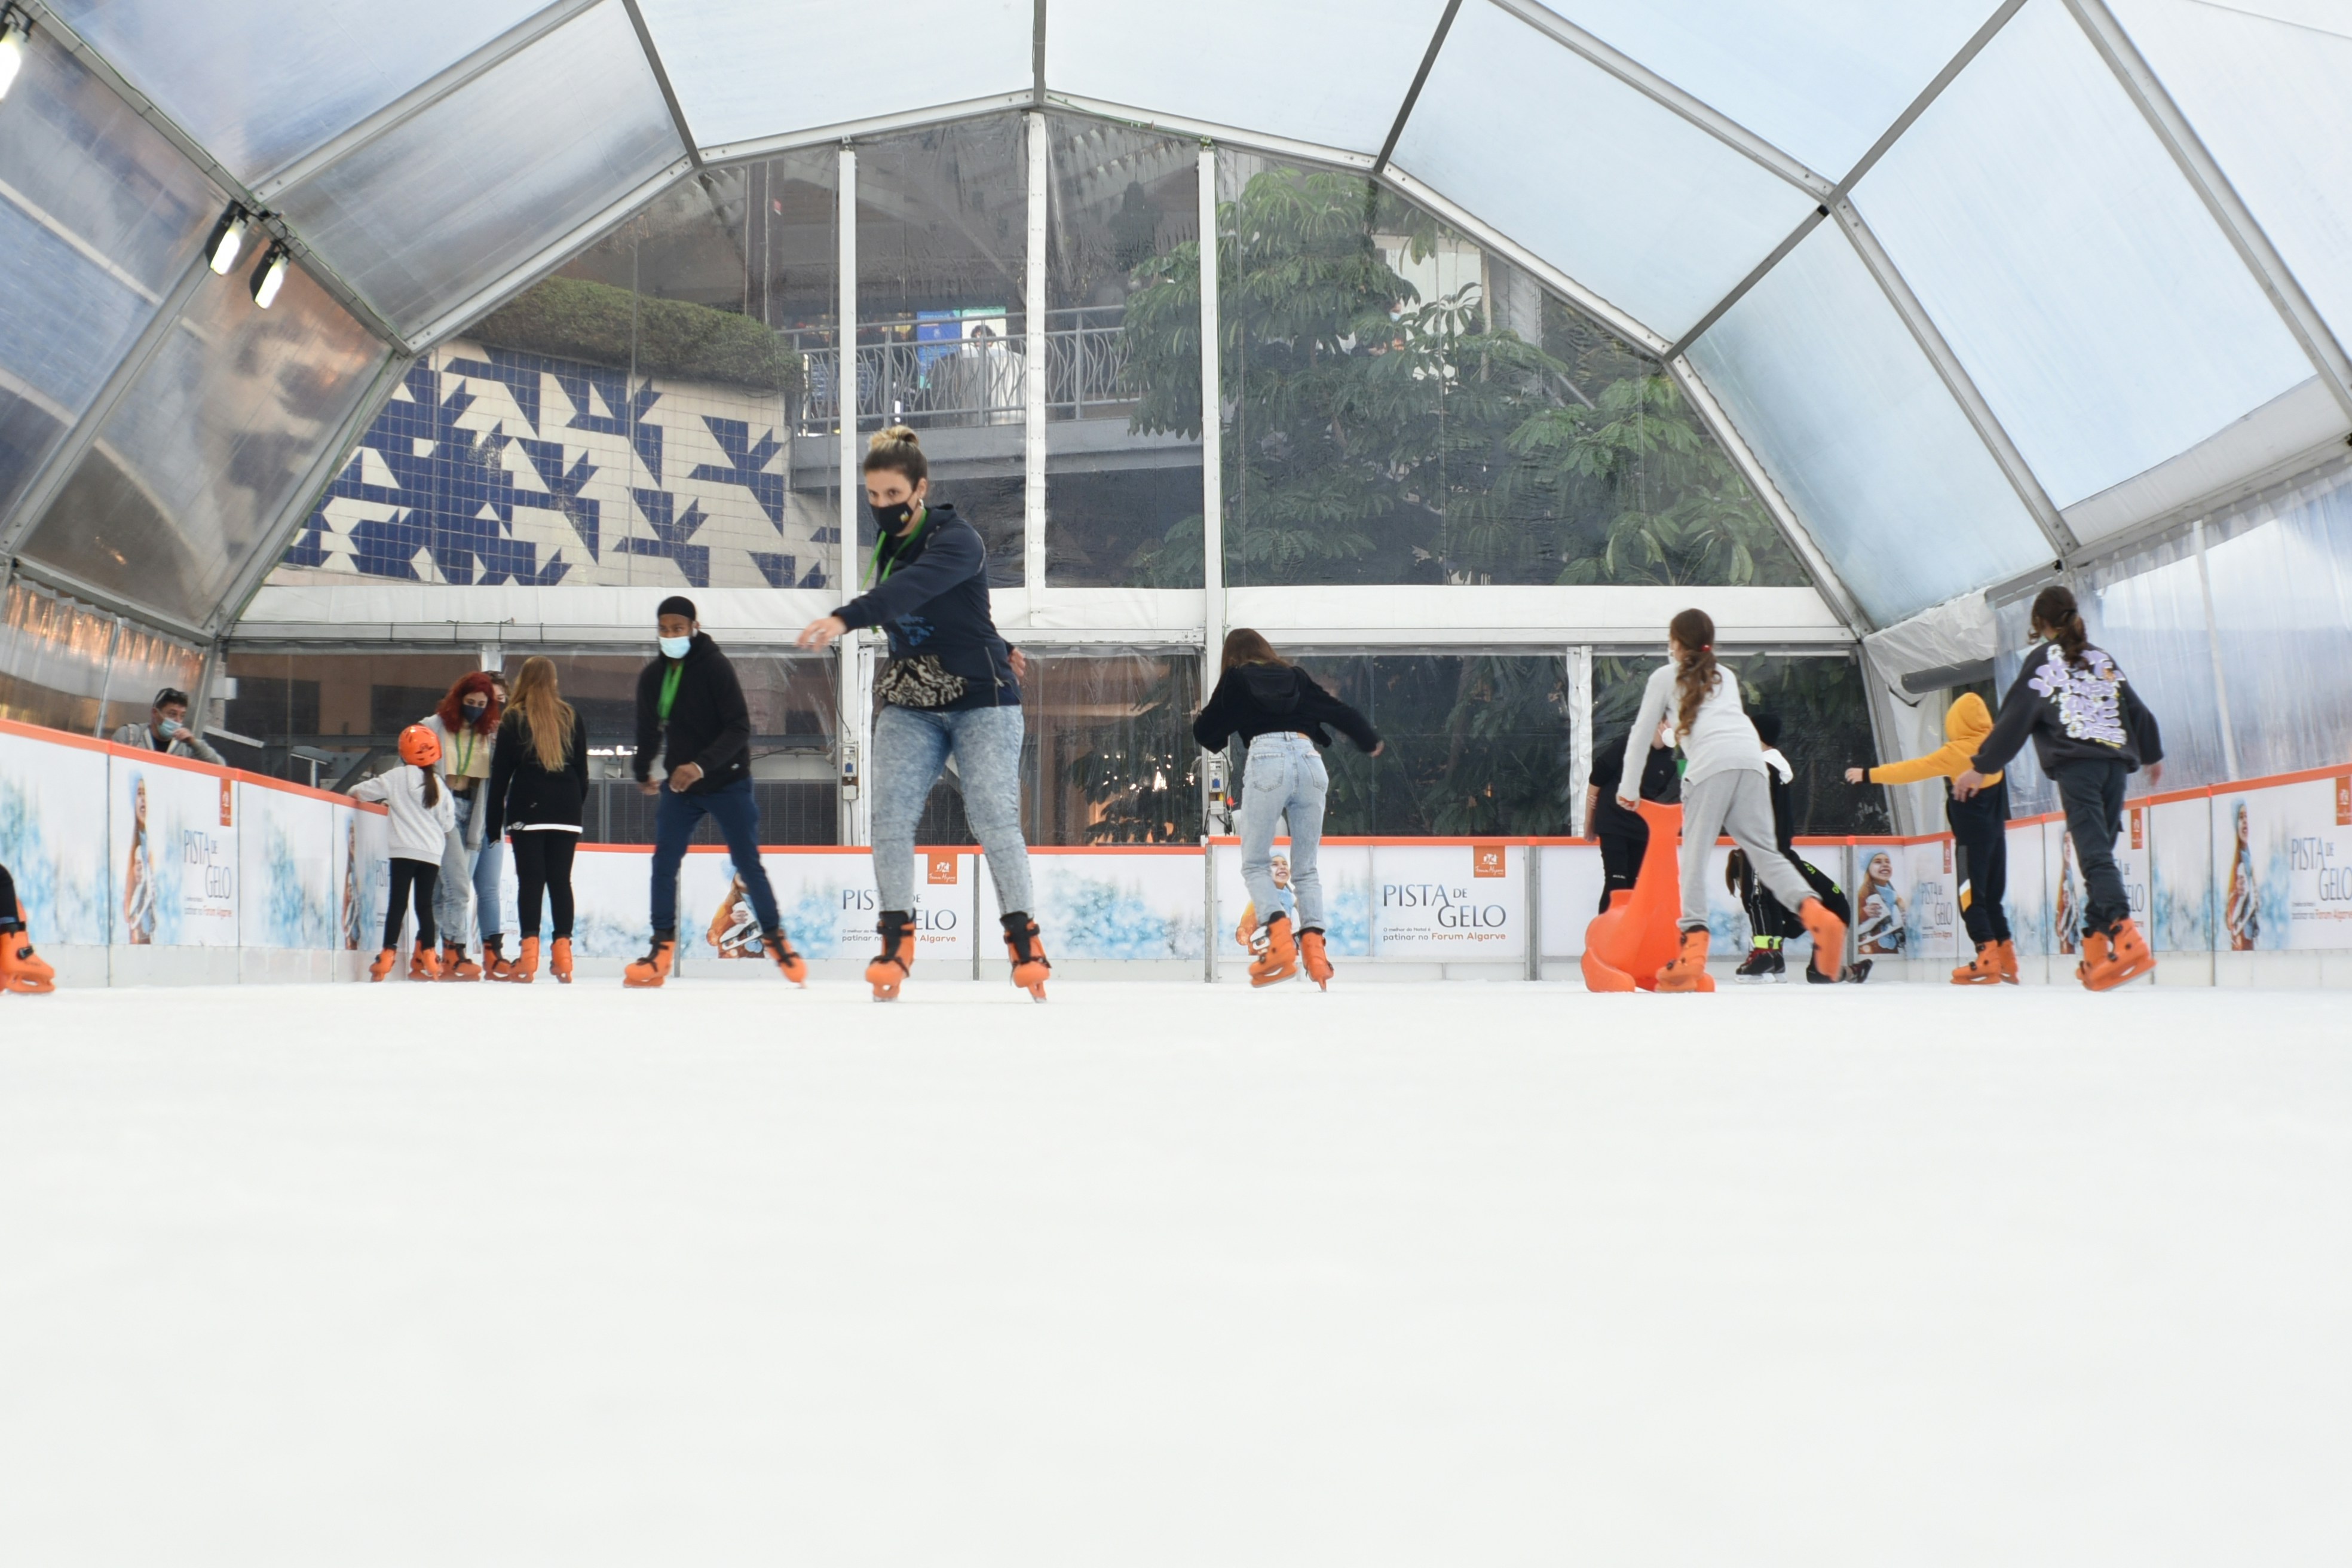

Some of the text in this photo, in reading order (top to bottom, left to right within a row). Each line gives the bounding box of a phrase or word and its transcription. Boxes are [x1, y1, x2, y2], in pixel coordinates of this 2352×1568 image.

[184, 829, 210, 865] PISTA
[2291, 837, 2324, 870] PISTA
[205, 865, 232, 899] GELO
[2319, 866, 2352, 901] GELO
[1383, 884, 1468, 906] PISTA DE
[915, 909, 957, 930] ELO
[1438, 904, 1506, 927] GELO
[842, 935, 872, 943] patinar
[920, 934, 956, 944] Algarve
[1383, 933, 1416, 942] patinar
[1466, 932, 1506, 942] Algarve
